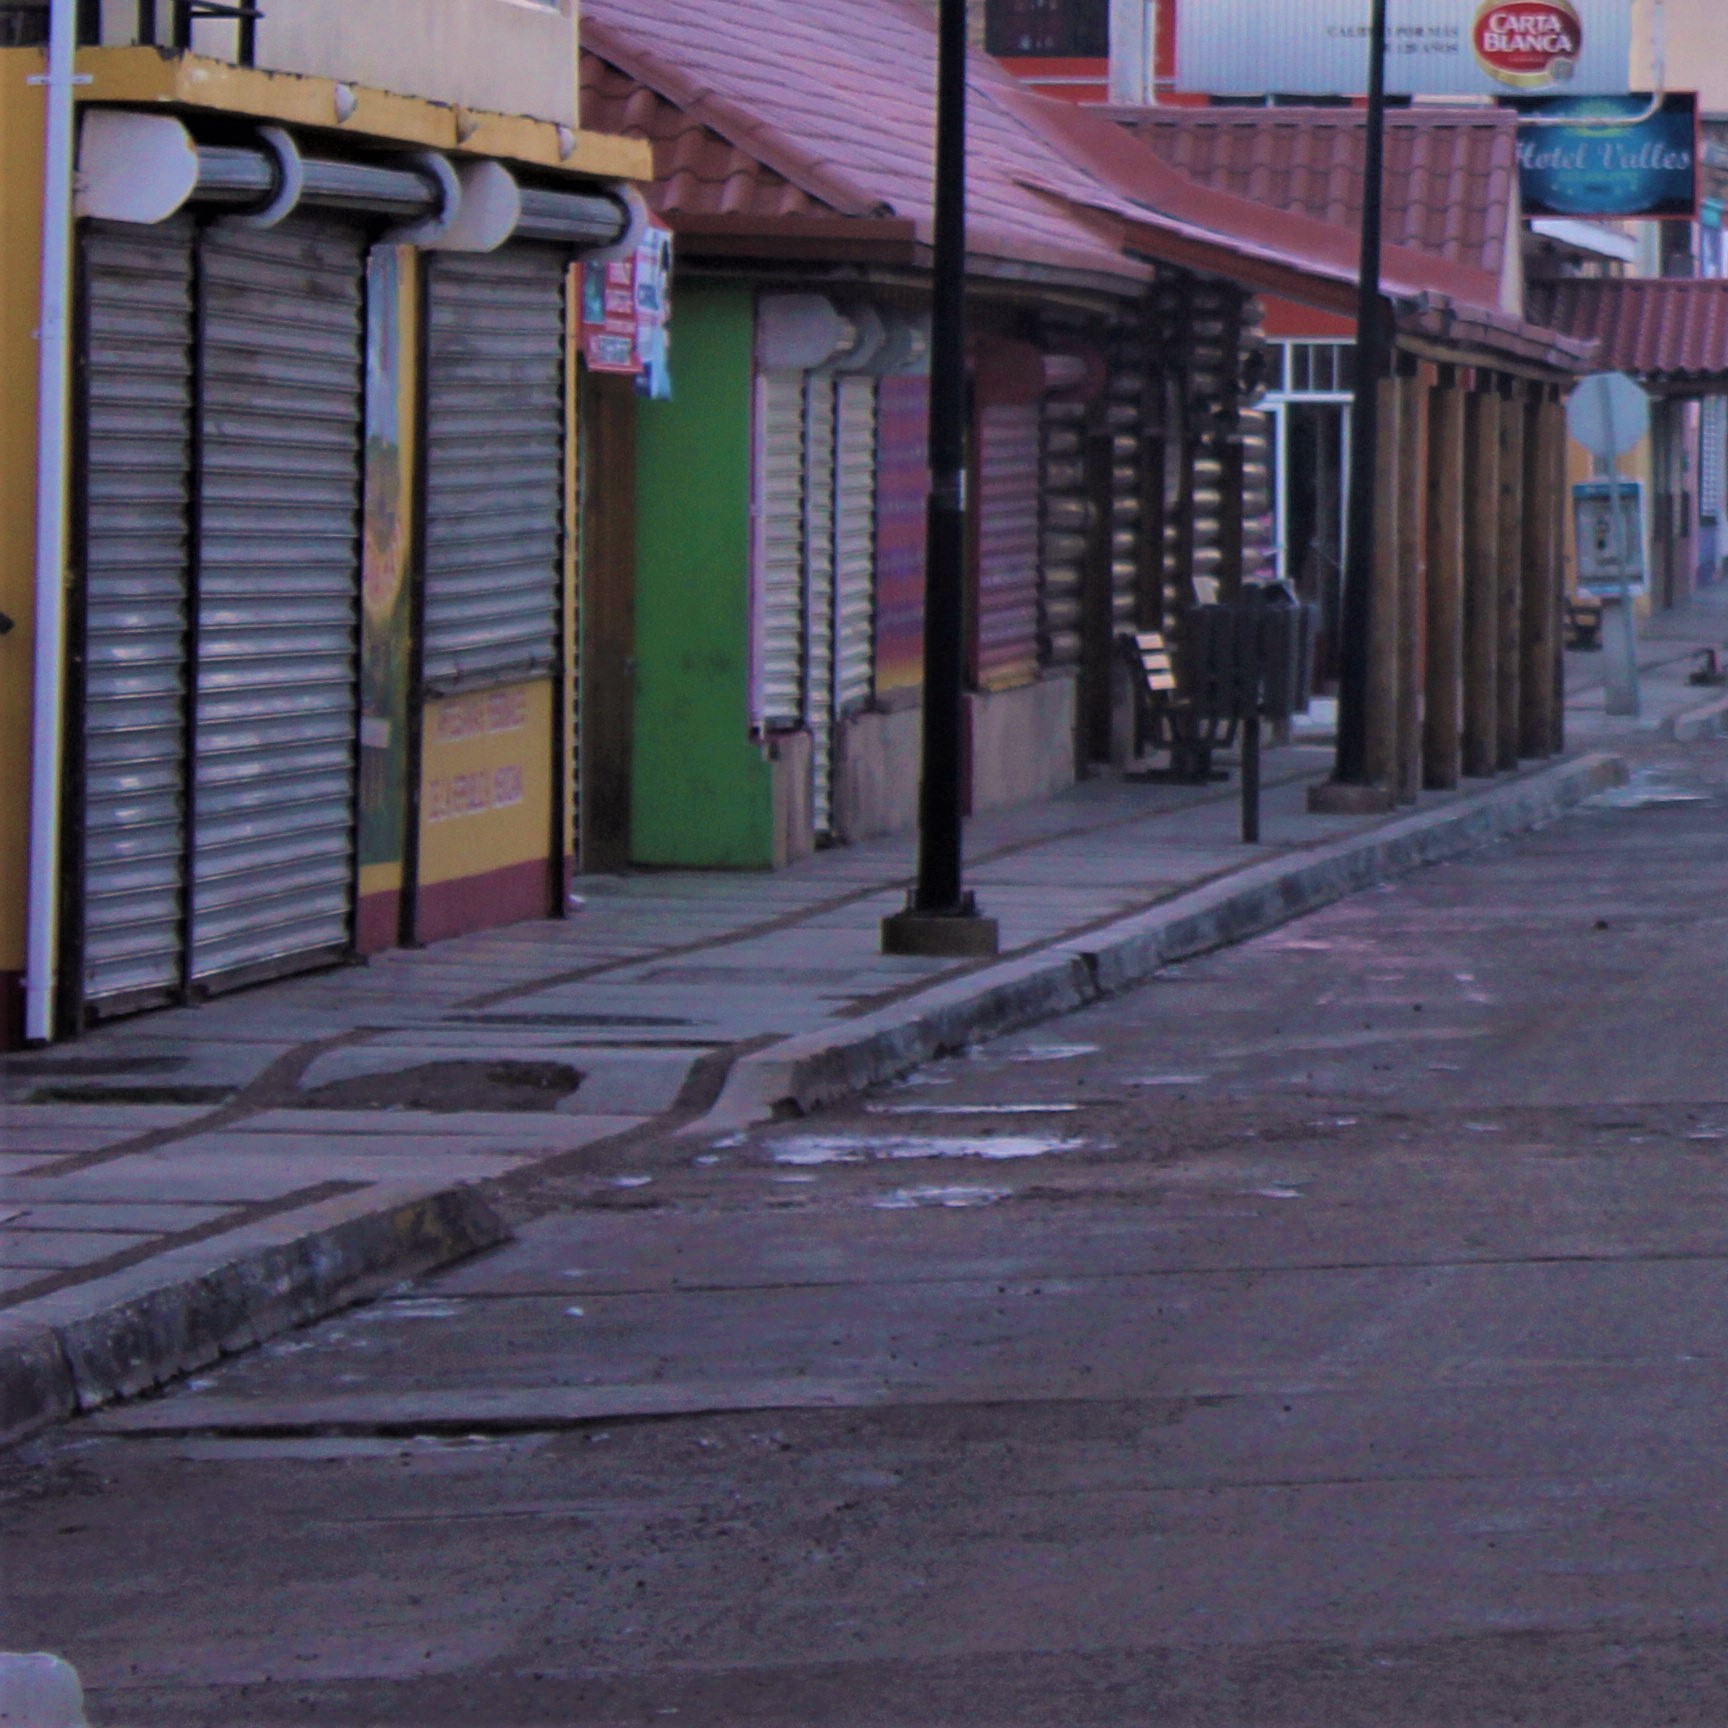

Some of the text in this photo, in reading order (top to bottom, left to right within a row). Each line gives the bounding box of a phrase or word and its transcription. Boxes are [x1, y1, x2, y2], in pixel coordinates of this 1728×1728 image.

[1488, 13, 1562, 34] CARTA
[1483, 32, 1573, 54] BLANCA
[1516, 141, 1691, 170] Hotel Valles
